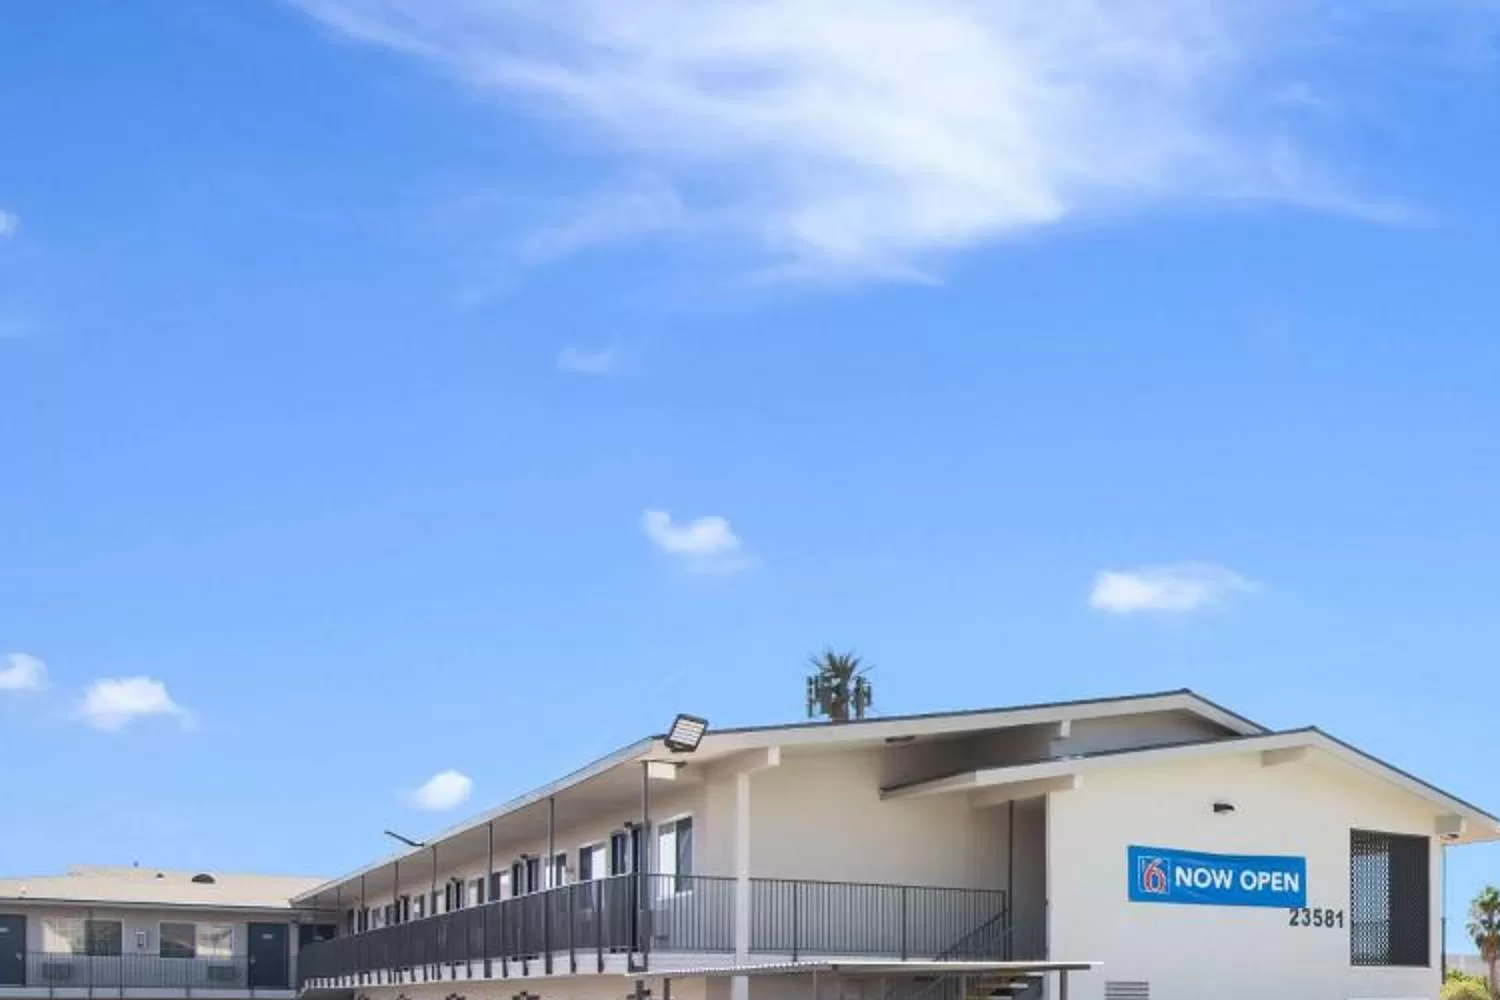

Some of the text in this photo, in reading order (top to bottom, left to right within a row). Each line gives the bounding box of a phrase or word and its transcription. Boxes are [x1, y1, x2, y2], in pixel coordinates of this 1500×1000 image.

[1143, 858, 1166, 893] 6
[1175, 865, 1233, 889] NOW
[1240, 870, 1300, 892] OPEN
[1288, 907, 1344, 929] 23581
